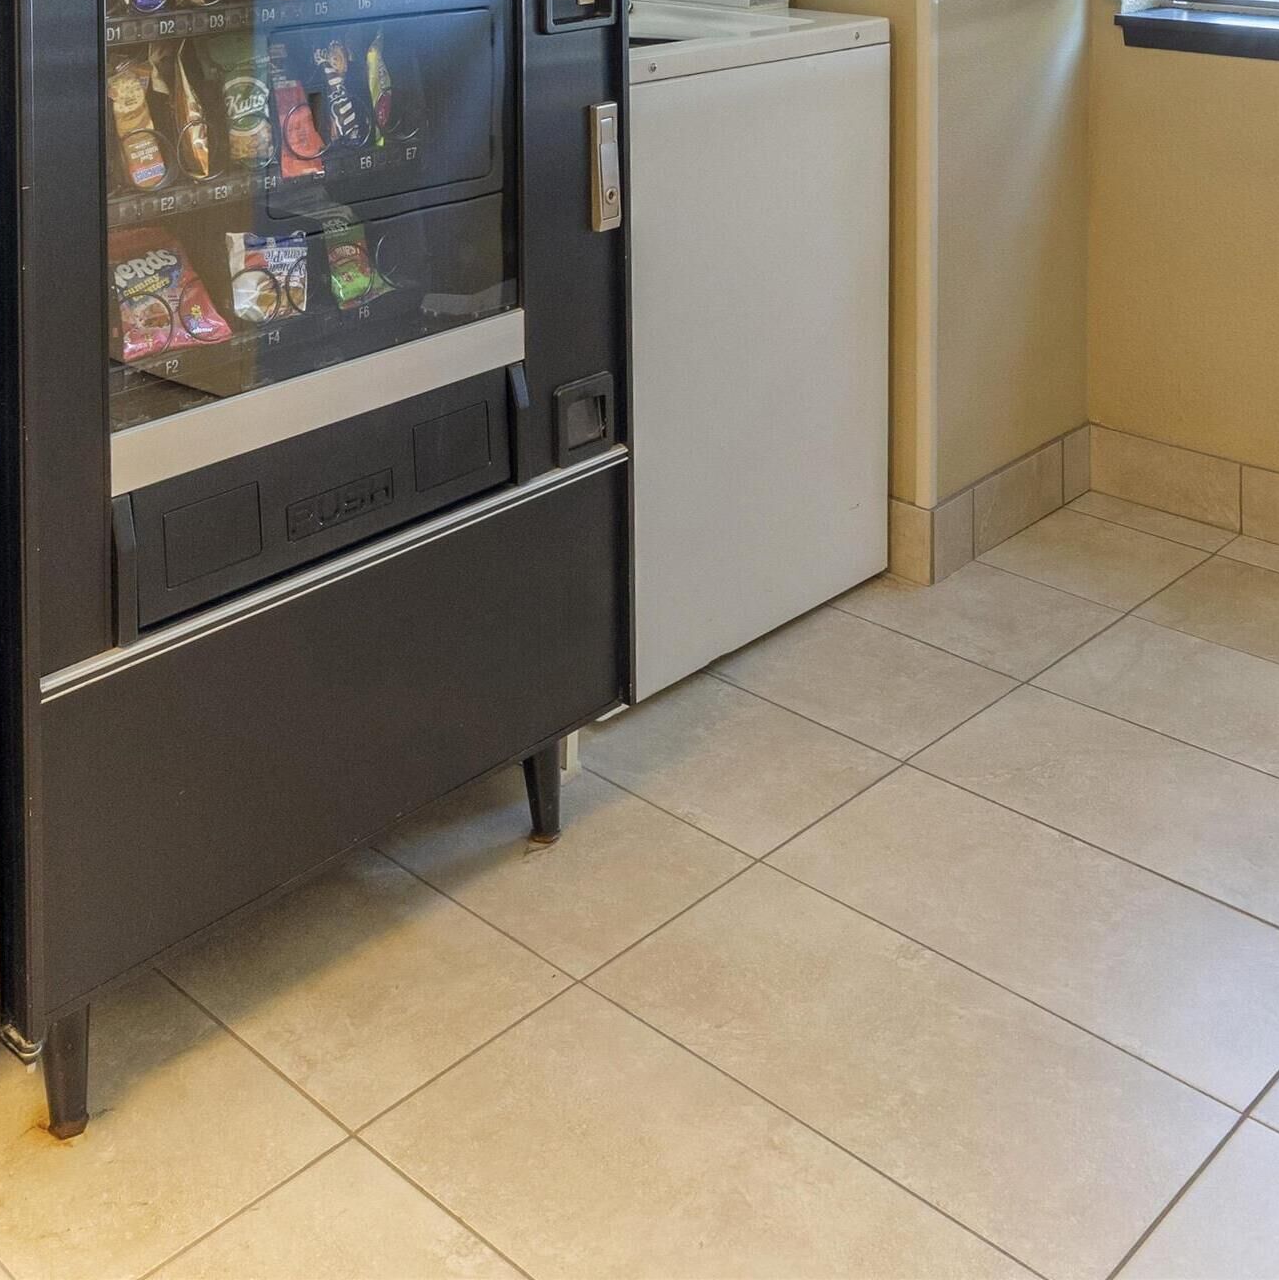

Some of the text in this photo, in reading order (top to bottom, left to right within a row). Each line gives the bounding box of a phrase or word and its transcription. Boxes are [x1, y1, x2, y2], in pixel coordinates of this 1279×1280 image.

[262, 9, 275, 21] D4
[315, 2, 328, 15] D5
[160, 20, 175, 34] D2
[210, 15, 224, 28] D3
[106, 27, 120, 41] D1
[406, 146, 417, 160] E7
[360, 156, 372, 169] E6
[264, 176, 276, 189] E4
[214, 185, 227, 200] E3
[161, 196, 174, 211] E2
[358, 305, 370, 319] F6
[268, 330, 280, 344] F4
[165, 359, 179, 374] F2
